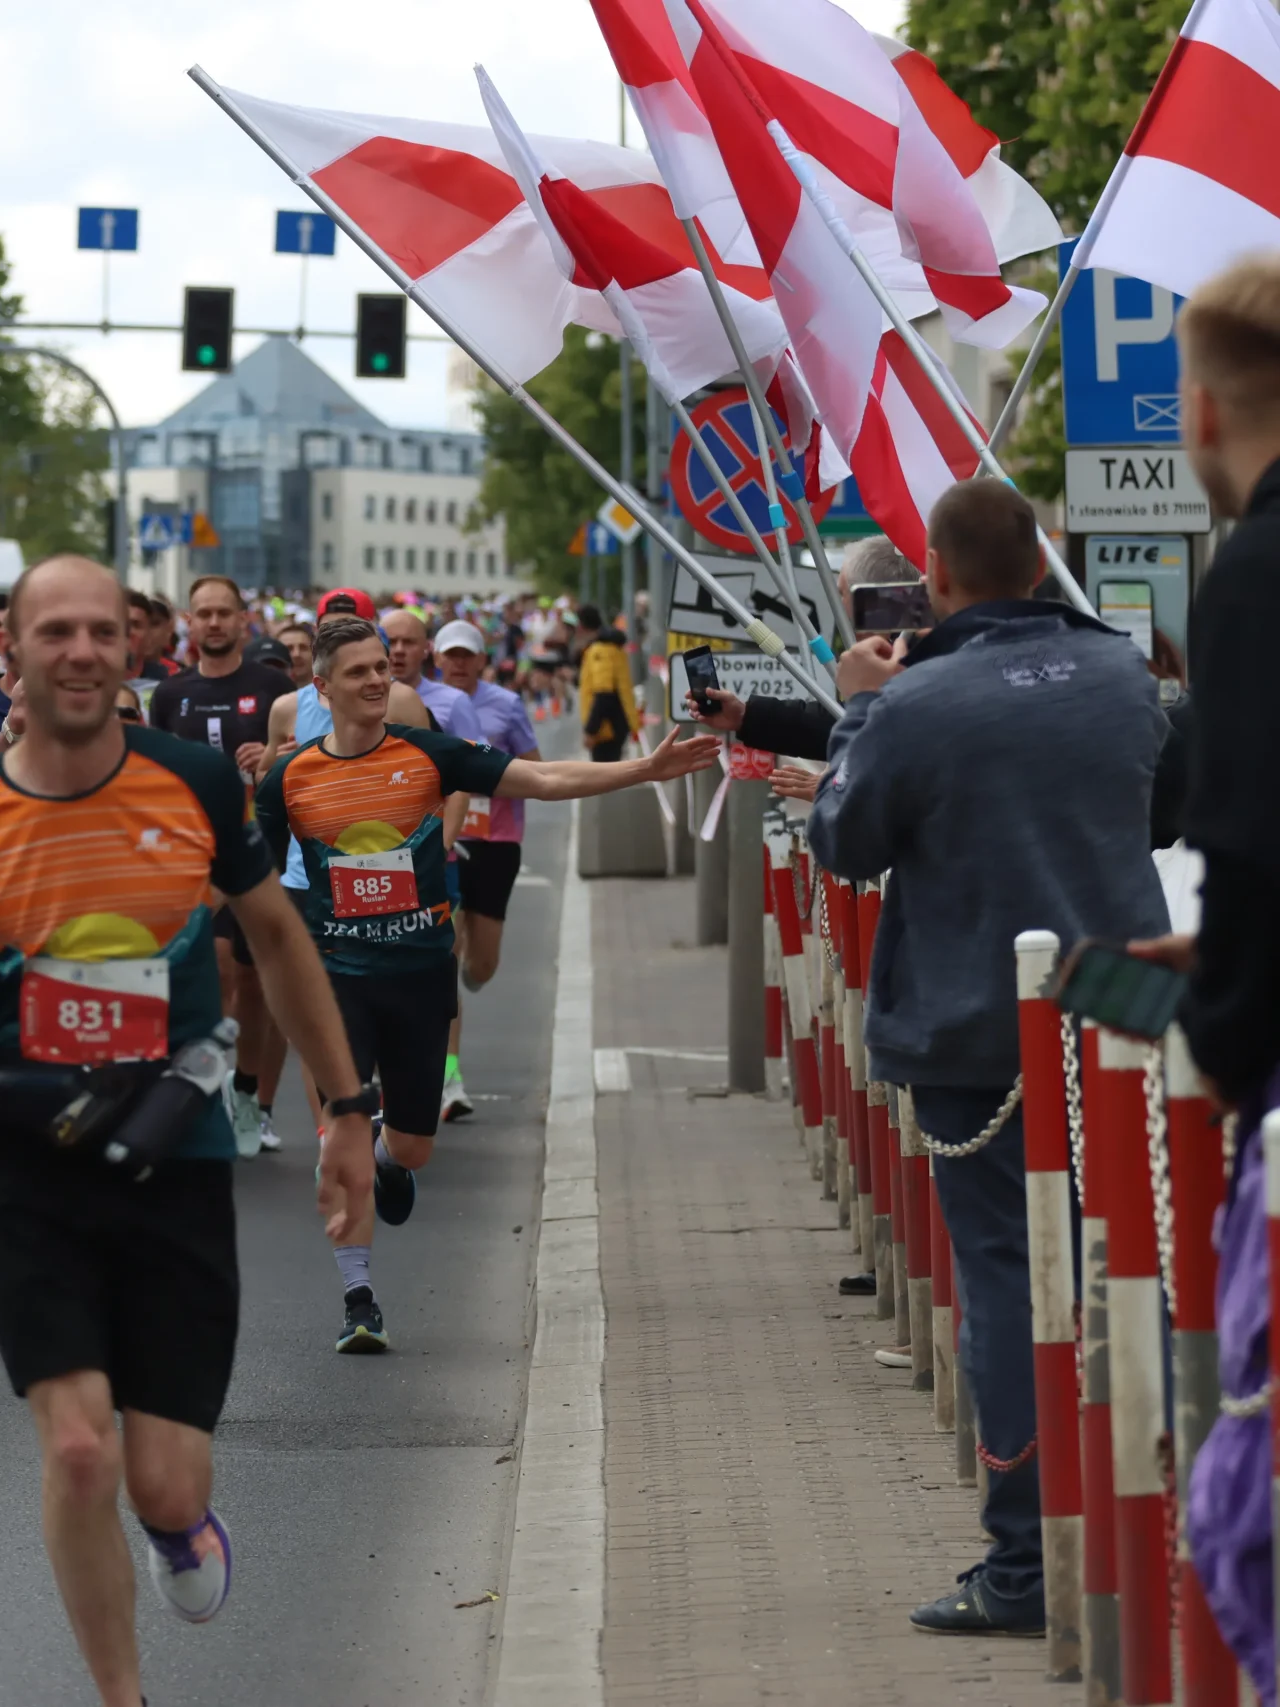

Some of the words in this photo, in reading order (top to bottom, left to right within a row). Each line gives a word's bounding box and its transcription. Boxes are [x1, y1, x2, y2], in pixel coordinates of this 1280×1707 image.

[1093, 268, 1174, 382] P
[1099, 458, 1175, 490] TAXI
[1079, 503, 1147, 517] stanowisko
[1152, 502, 1169, 516] 85
[1097, 545, 1160, 564] LITE
[352, 875, 393, 897] 885
[361, 894, 388, 903] Ruslan
[386, 907, 433, 937] RUN
[57, 1000, 124, 1030] 831
